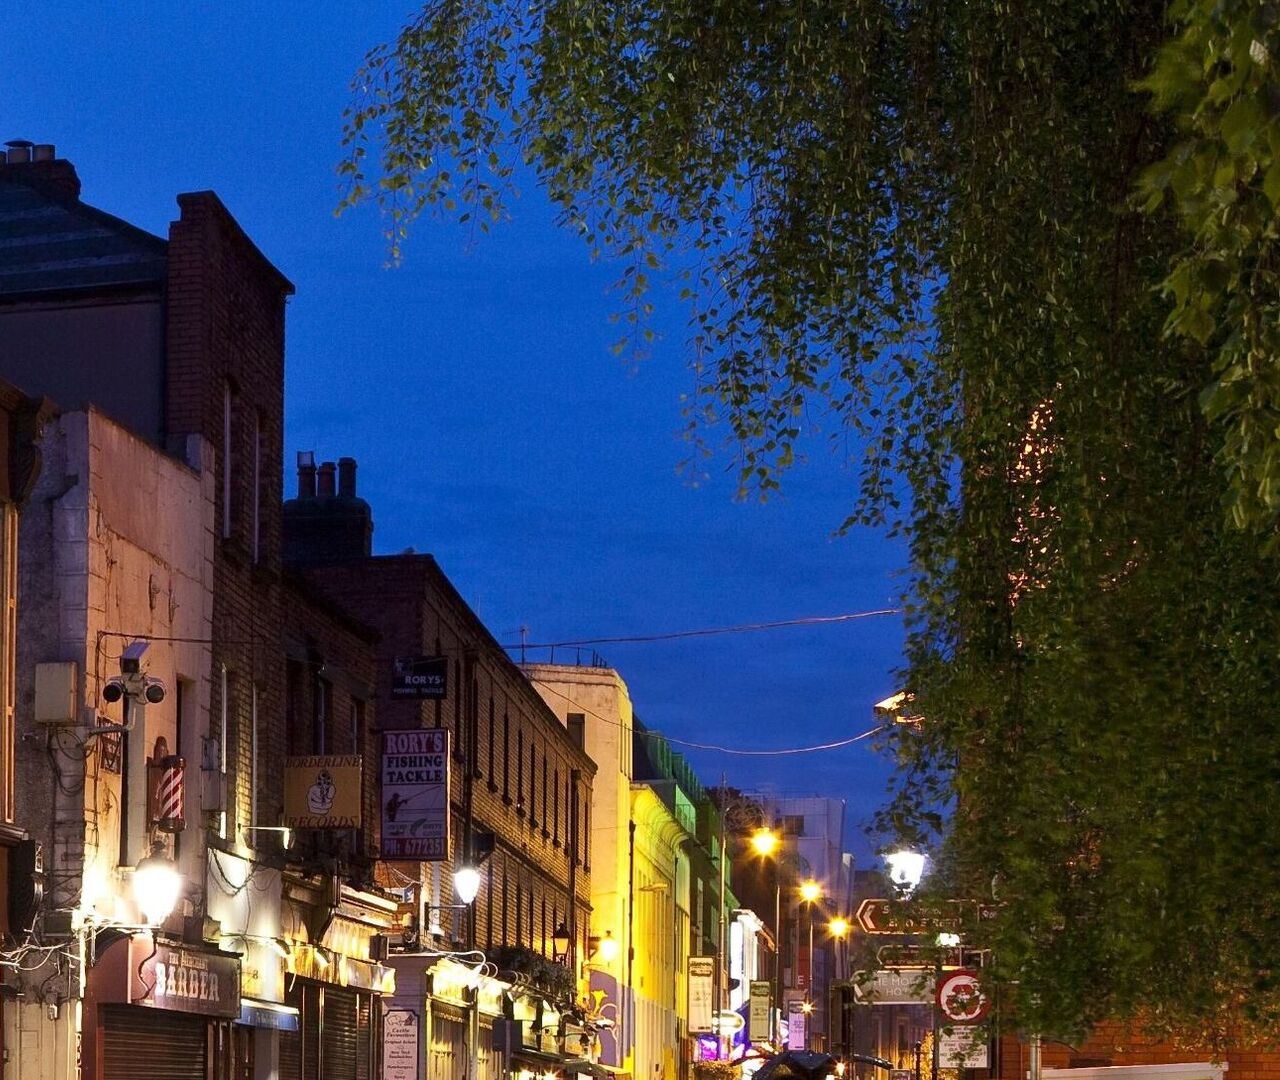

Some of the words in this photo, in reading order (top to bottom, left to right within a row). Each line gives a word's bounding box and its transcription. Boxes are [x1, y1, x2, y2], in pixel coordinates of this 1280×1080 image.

[386, 732, 443, 754] RORY'S
[386, 755, 443, 768] FISHING
[386, 770, 443, 783] TACKLE
[155, 961, 220, 1002] BARBER
